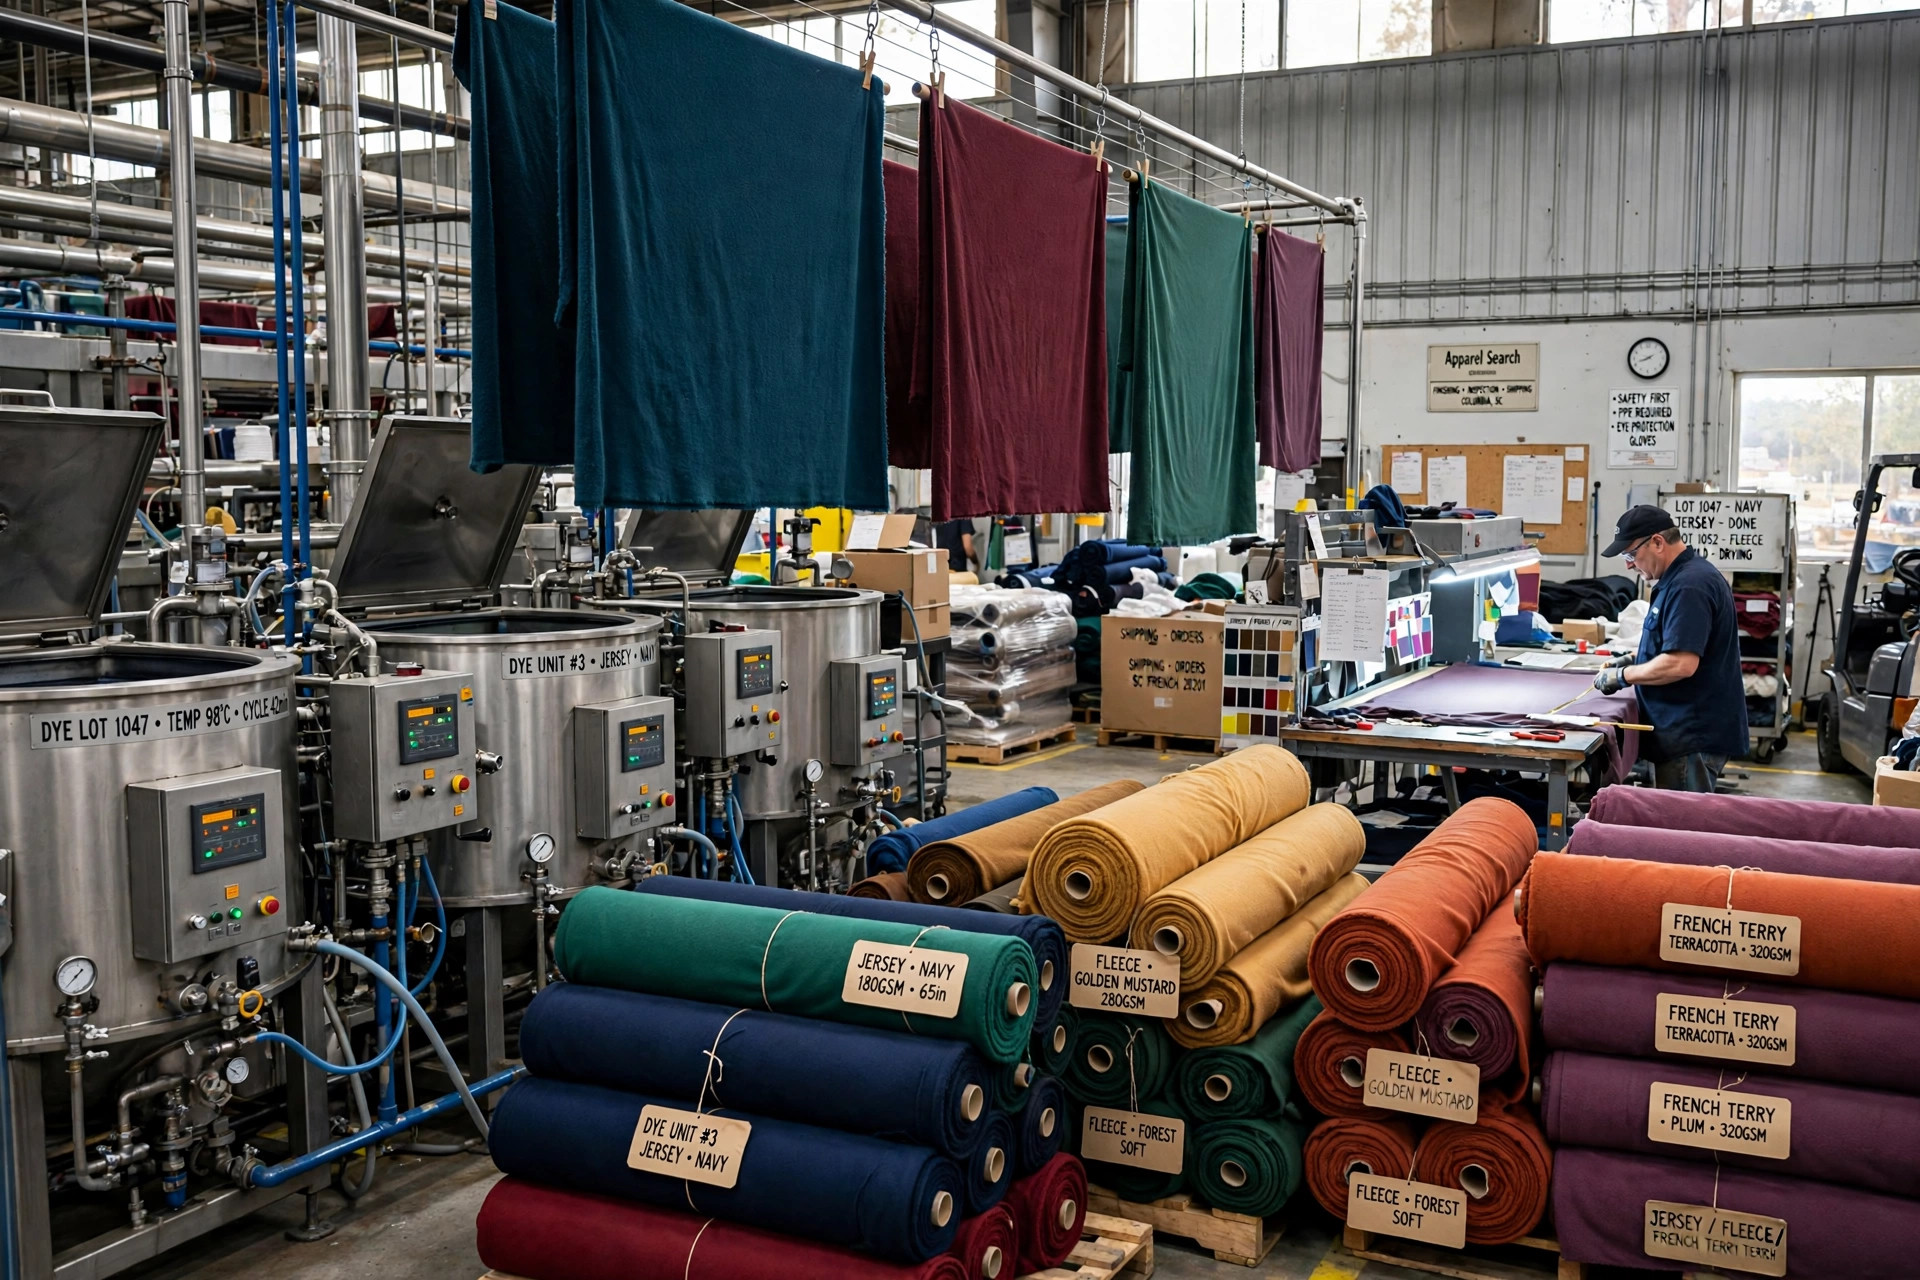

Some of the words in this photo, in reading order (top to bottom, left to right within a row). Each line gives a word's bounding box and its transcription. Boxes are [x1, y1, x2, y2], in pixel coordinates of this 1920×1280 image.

[1445, 349, 1483, 369] Apparel
[1487, 349, 1521, 365] Search
[1617, 392, 1647, 404] SAFETY
[1650, 392, 1671, 404] FIRST
[1618, 407, 1634, 418] PPE
[1617, 421, 1630, 432] EYE
[1631, 420, 1675, 432] PROTECTION
[1629, 435, 1656, 447] GLOVES
[1675, 500, 1695, 513] LOT
[1700, 500, 1722, 513] 1047
[1735, 500, 1763, 513] NAVY
[1675, 516, 1715, 529] JERSEY
[1728, 517, 1757, 530] DONE
[1680, 533, 1694, 544] OT
[1698, 534, 1719, 545] 1052
[1729, 534, 1764, 546] FLEECE
[509, 657, 533, 675] DYE
[538, 655, 565, 673] UNIT
[570, 653, 586, 671] #3
[600, 648, 632, 669] JERSEY
[41, 720, 73, 743] DYE
[79, 717, 108, 740] LOT
[115, 714, 149, 737] 1047
[167, 708, 201, 732] TEMP
[242, 697, 270, 721] CYCLE
[1674, 914, 1732, 936] FRENCH
[1739, 921, 1787, 942] TERRY
[1669, 934, 1738, 956] TERRACOTTA
[1749, 944, 1792, 962] 320GSM
[857, 952, 907, 974] JERSEY
[919, 961, 956, 981] NAVY
[1096, 954, 1141, 973] FLEECE
[858, 975, 905, 996] 180GSM
[919, 983, 947, 1002] 65in
[1075, 970, 1120, 990] GOLDEN
[1124, 976, 1177, 995] MUSTARD
[1101, 992, 1146, 1010] 280GSM
[1669, 1004, 1726, 1026] FRENCH
[1733, 1011, 1780, 1031] TERRY
[1665, 1025, 1735, 1047] TERRACOTTA
[1746, 1034, 1788, 1052] 320GSM
[1389, 1062, 1441, 1086] FLEECE
[1368, 1079, 1415, 1102] GOLDEN
[1420, 1087, 1474, 1111] MUSTARD
[1663, 1093, 1721, 1116] FRENCH
[1728, 1102, 1776, 1124] TERRY
[642, 1117, 668, 1138] DYE
[669, 1121, 698, 1143] UNIT
[700, 1127, 719, 1147] #3
[1088, 1116, 1128, 1136] FLEECE
[1138, 1123, 1177, 1144] FOREST
[1671, 1115, 1705, 1135] PLUM
[1719, 1122, 1767, 1143] 320GSM
[639, 1140, 685, 1165] JERSEY
[694, 1150, 729, 1173] NAVY
[1120, 1140, 1147, 1158] SOFT
[1356, 1183, 1400, 1206] FLEECE
[1415, 1193, 1460, 1217] FOREST
[1392, 1209, 1424, 1229] SOFT
[1650, 1209, 1703, 1232] JERSEY
[1653, 1230, 1699, 1250] FRENCH
